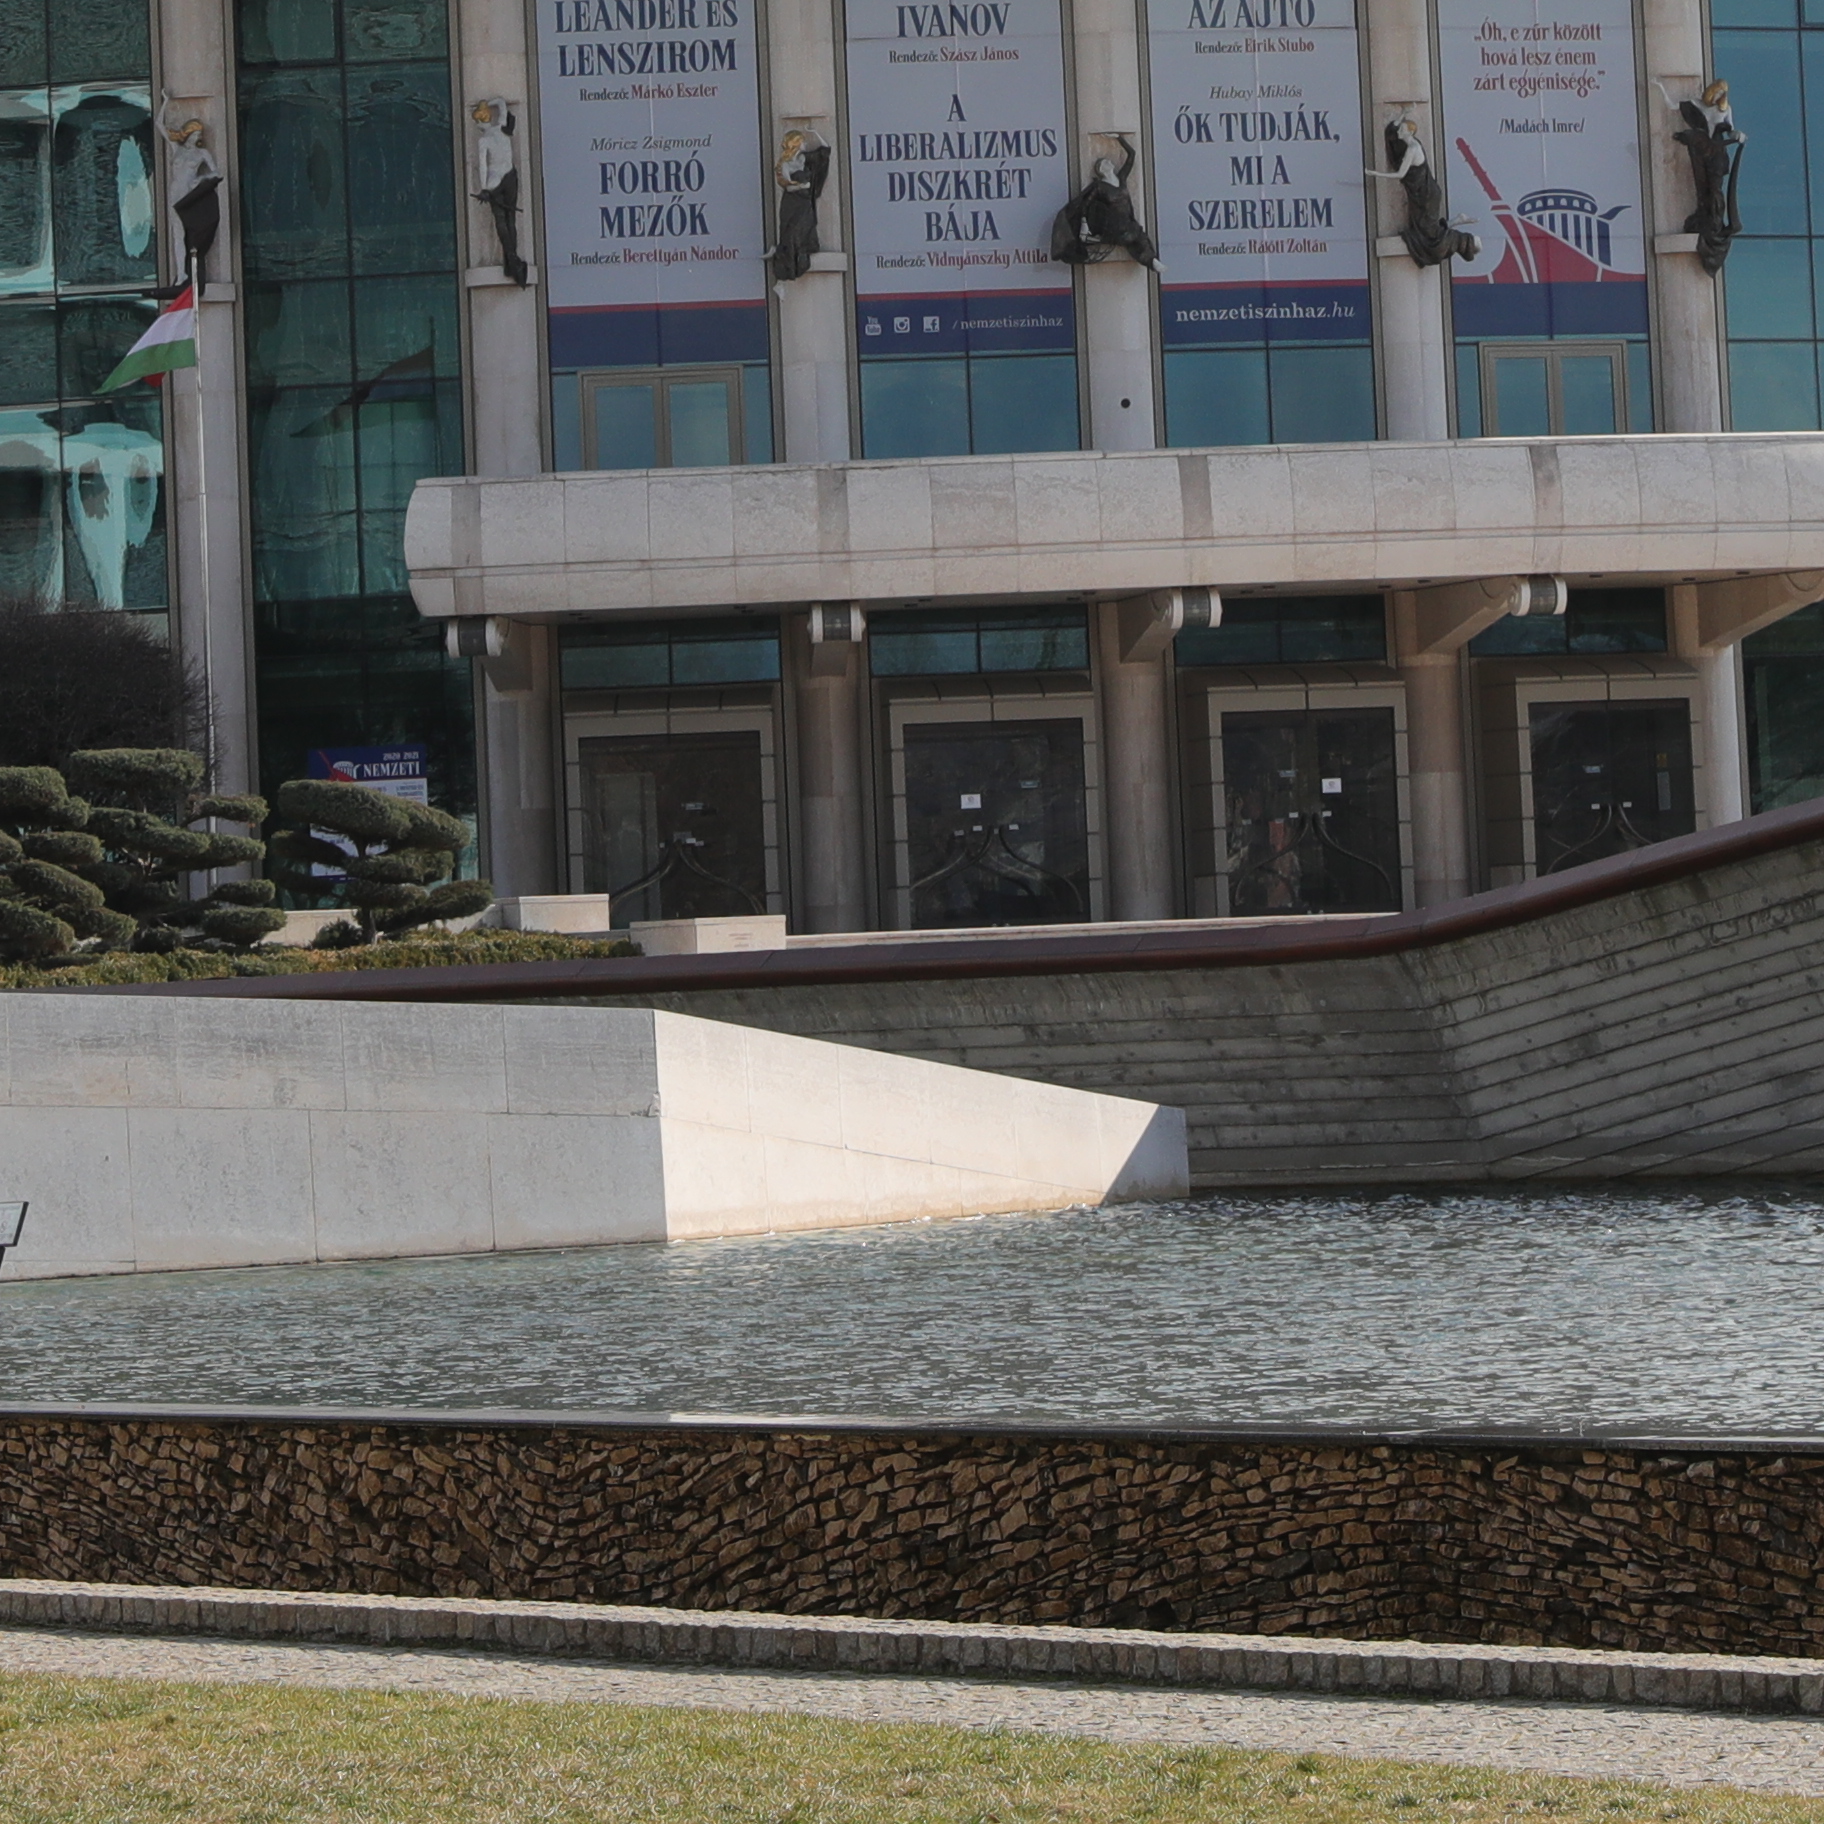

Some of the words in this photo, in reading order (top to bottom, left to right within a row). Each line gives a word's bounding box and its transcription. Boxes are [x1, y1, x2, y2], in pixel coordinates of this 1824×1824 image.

[896, 3, 1011, 38] IVANOV
[1510, 28, 1519, 41] e
[1553, 21, 1602, 41] között
[889, 49, 938, 63] Rendező:
[940, 46, 977, 62] Szász
[980, 45, 1019, 61] János
[1245, 38, 1277, 53] Eirik
[558, 38, 738, 77] LENSZIROM
[1481, 47, 1518, 66] hová
[1521, 46, 1552, 66] lesz
[1555, 47, 1596, 66] énem
[631, 84, 674, 99] Márkó
[676, 82, 718, 97] Eszter
[1474, 73, 1505, 91] zárt
[1209, 86, 1253, 101] Hubay
[1257, 84, 1302, 98] Miklós
[947, 94, 966, 122] A
[1174, 105, 1214, 144] ŐK
[1219, 103, 1340, 145] TUDJÁK,
[1499, 118, 1549, 134] /Madách
[1552, 117, 1585, 133] Imre/
[590, 138, 637, 151] Móricz
[642, 134, 712, 151] Zsigmond
[858, 128, 1058, 162] LIBERALIZMUS
[598, 150, 705, 195] FORRÓ
[1230, 155, 1264, 186] MI
[1271, 154, 1291, 185] A
[887, 161, 1032, 202] DISZKRÉT
[599, 195, 710, 238] MEZŐK
[925, 203, 1000, 242] BÁJA
[1188, 198, 1334, 231] SZERELEM
[690, 244, 739, 261] Nándor
[1287, 238, 1327, 253] Zoltán
[926, 250, 1010, 270] Vidnyánszky
[1013, 248, 1048, 264] Attila
[1176, 302, 1355, 322] nemzetiszinhaz.hu
[363, 761, 420, 777] NEMZETI
